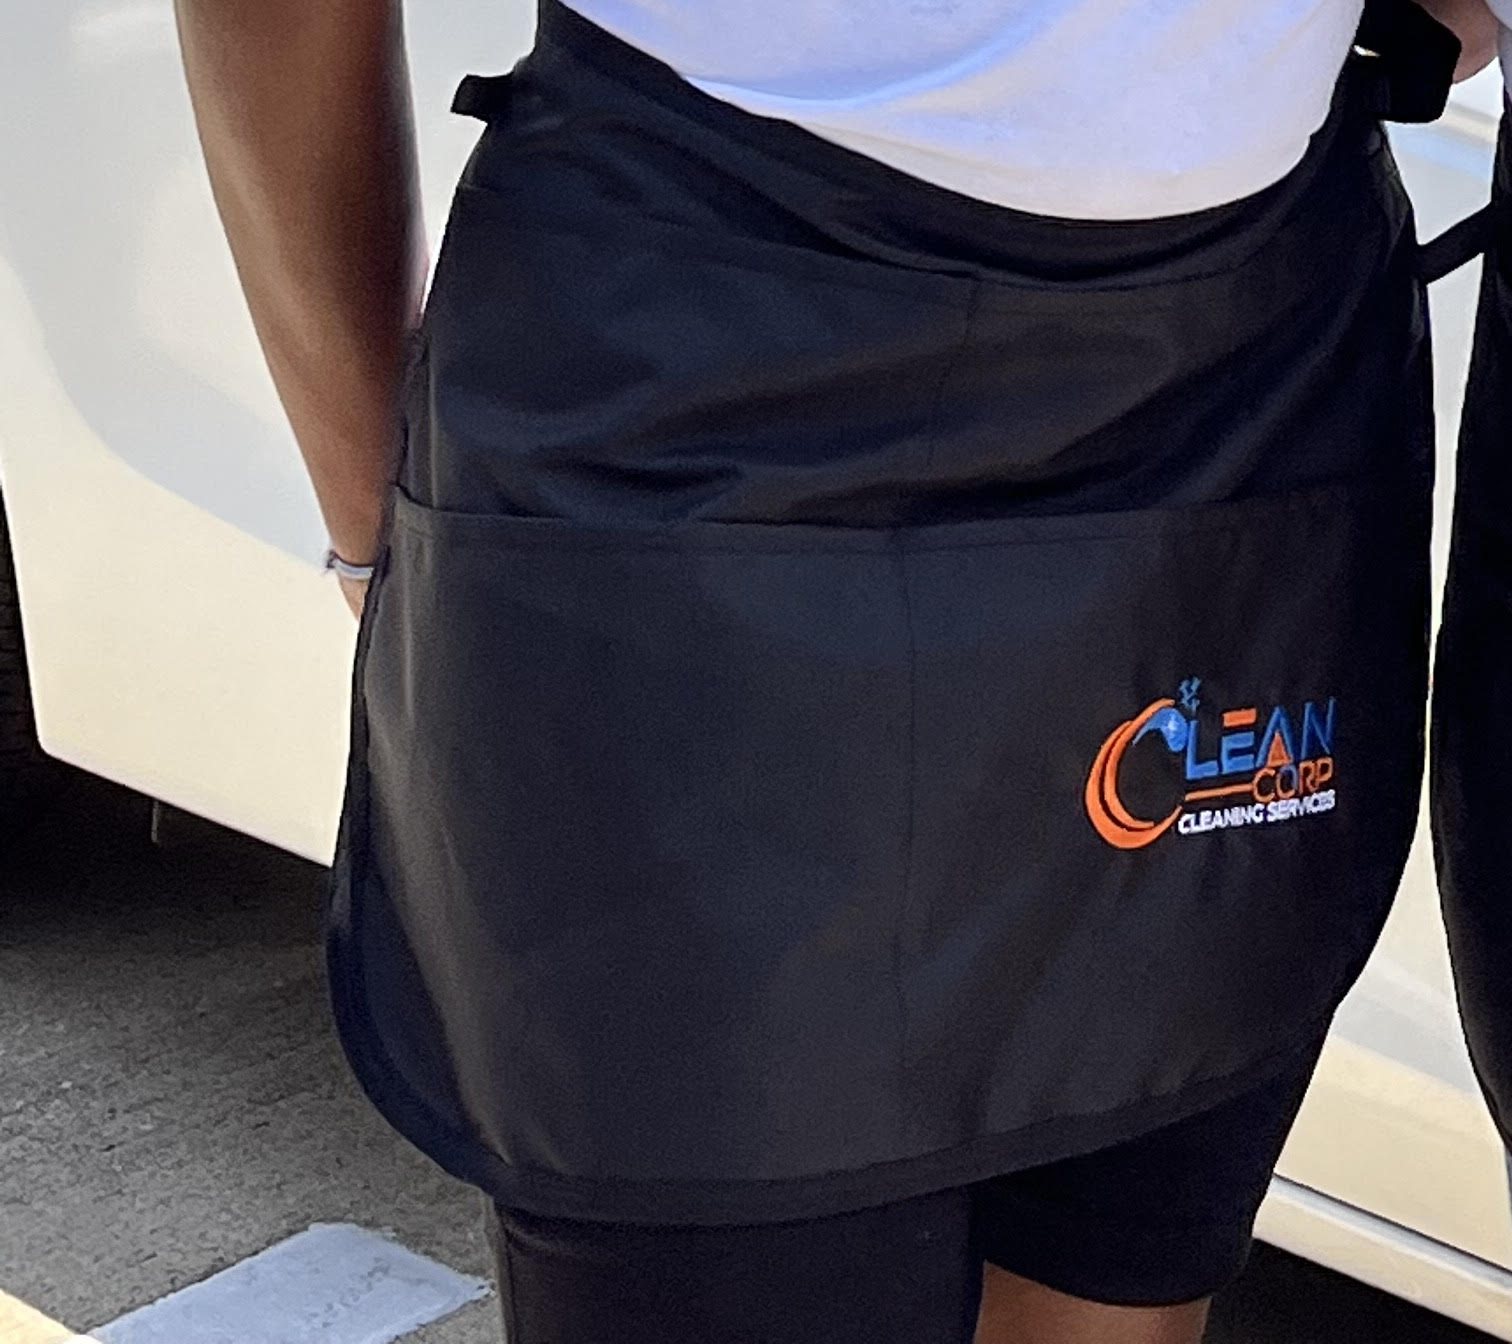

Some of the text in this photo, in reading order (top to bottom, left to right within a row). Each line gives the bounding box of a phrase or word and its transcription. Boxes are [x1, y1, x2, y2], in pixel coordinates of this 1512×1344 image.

[1085, 696, 1336, 849] CLEAN
[1253, 757, 1334, 803] CORP
[1178, 789, 1336, 835] CLEANING SERVICES
